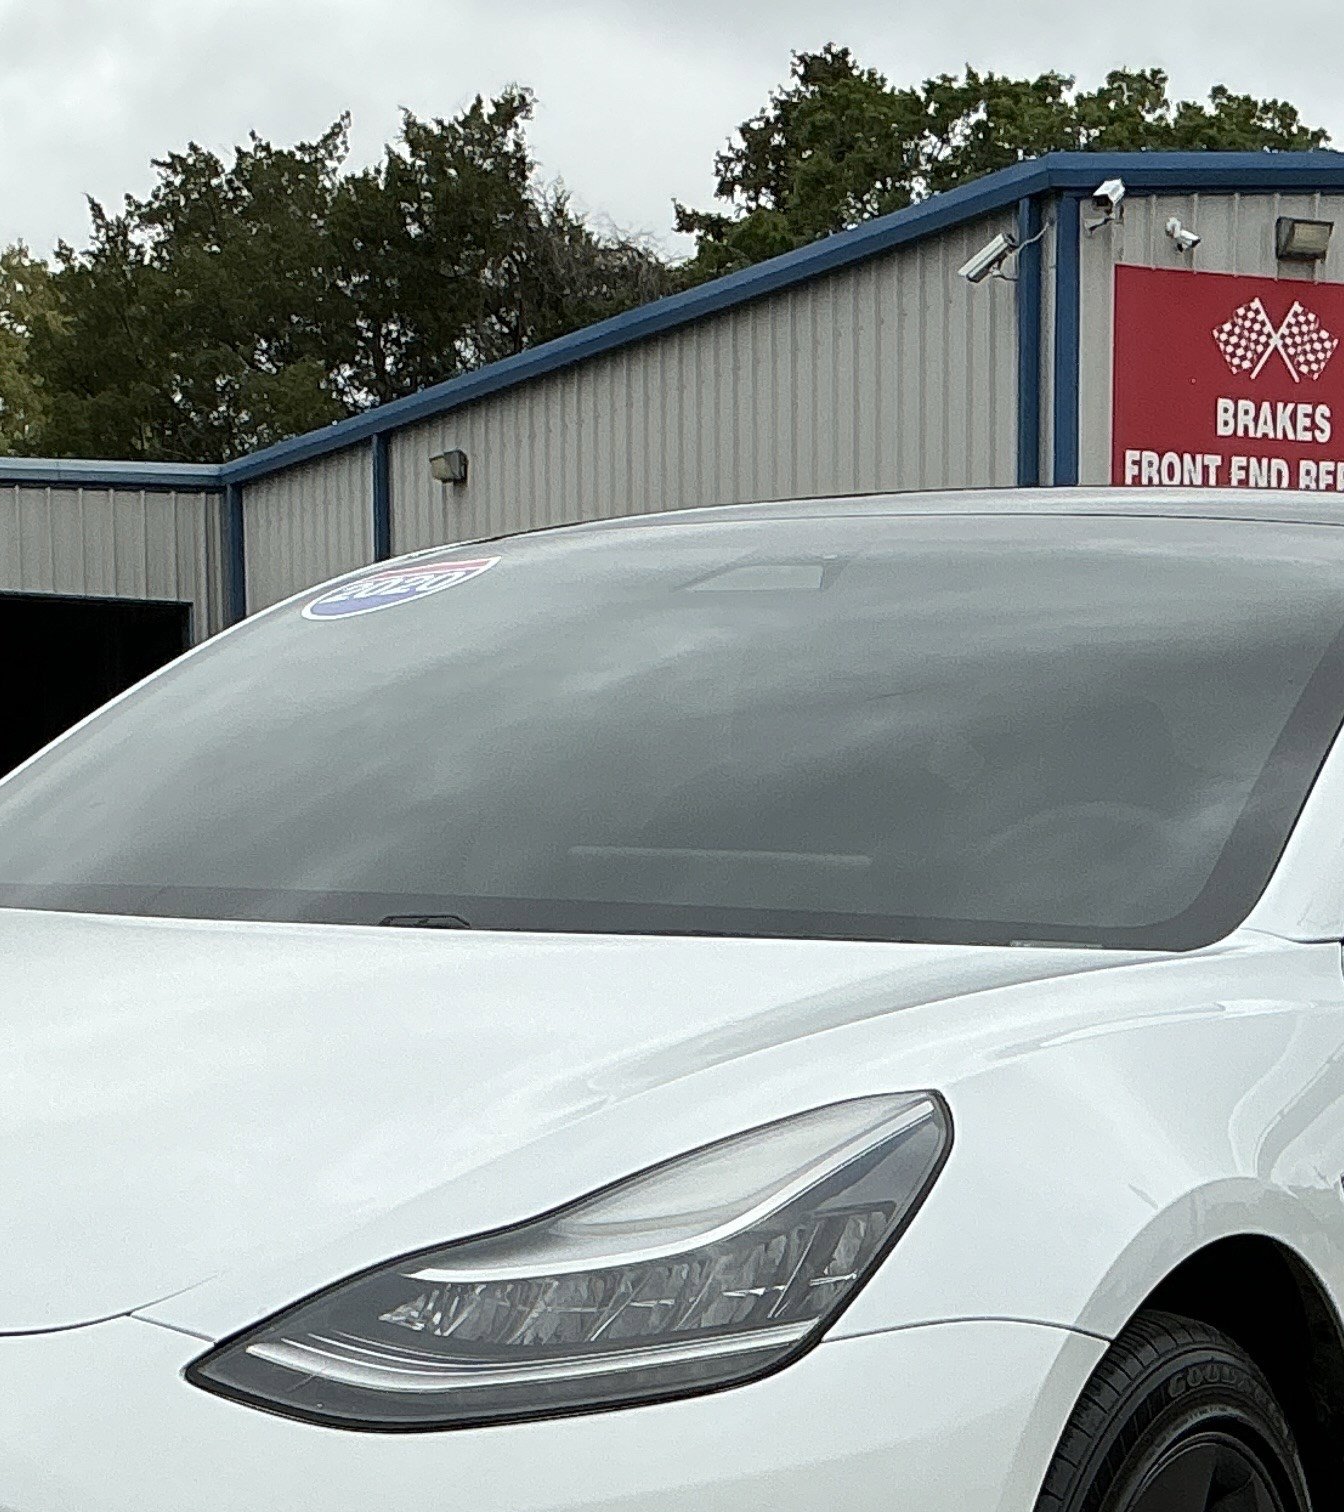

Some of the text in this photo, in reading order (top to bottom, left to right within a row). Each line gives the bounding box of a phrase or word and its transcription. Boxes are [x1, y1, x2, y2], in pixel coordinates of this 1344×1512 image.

[1216, 397, 1332, 442] BRAKES
[1124, 448, 1222, 486] FRONT
[1230, 455, 1290, 488] END
